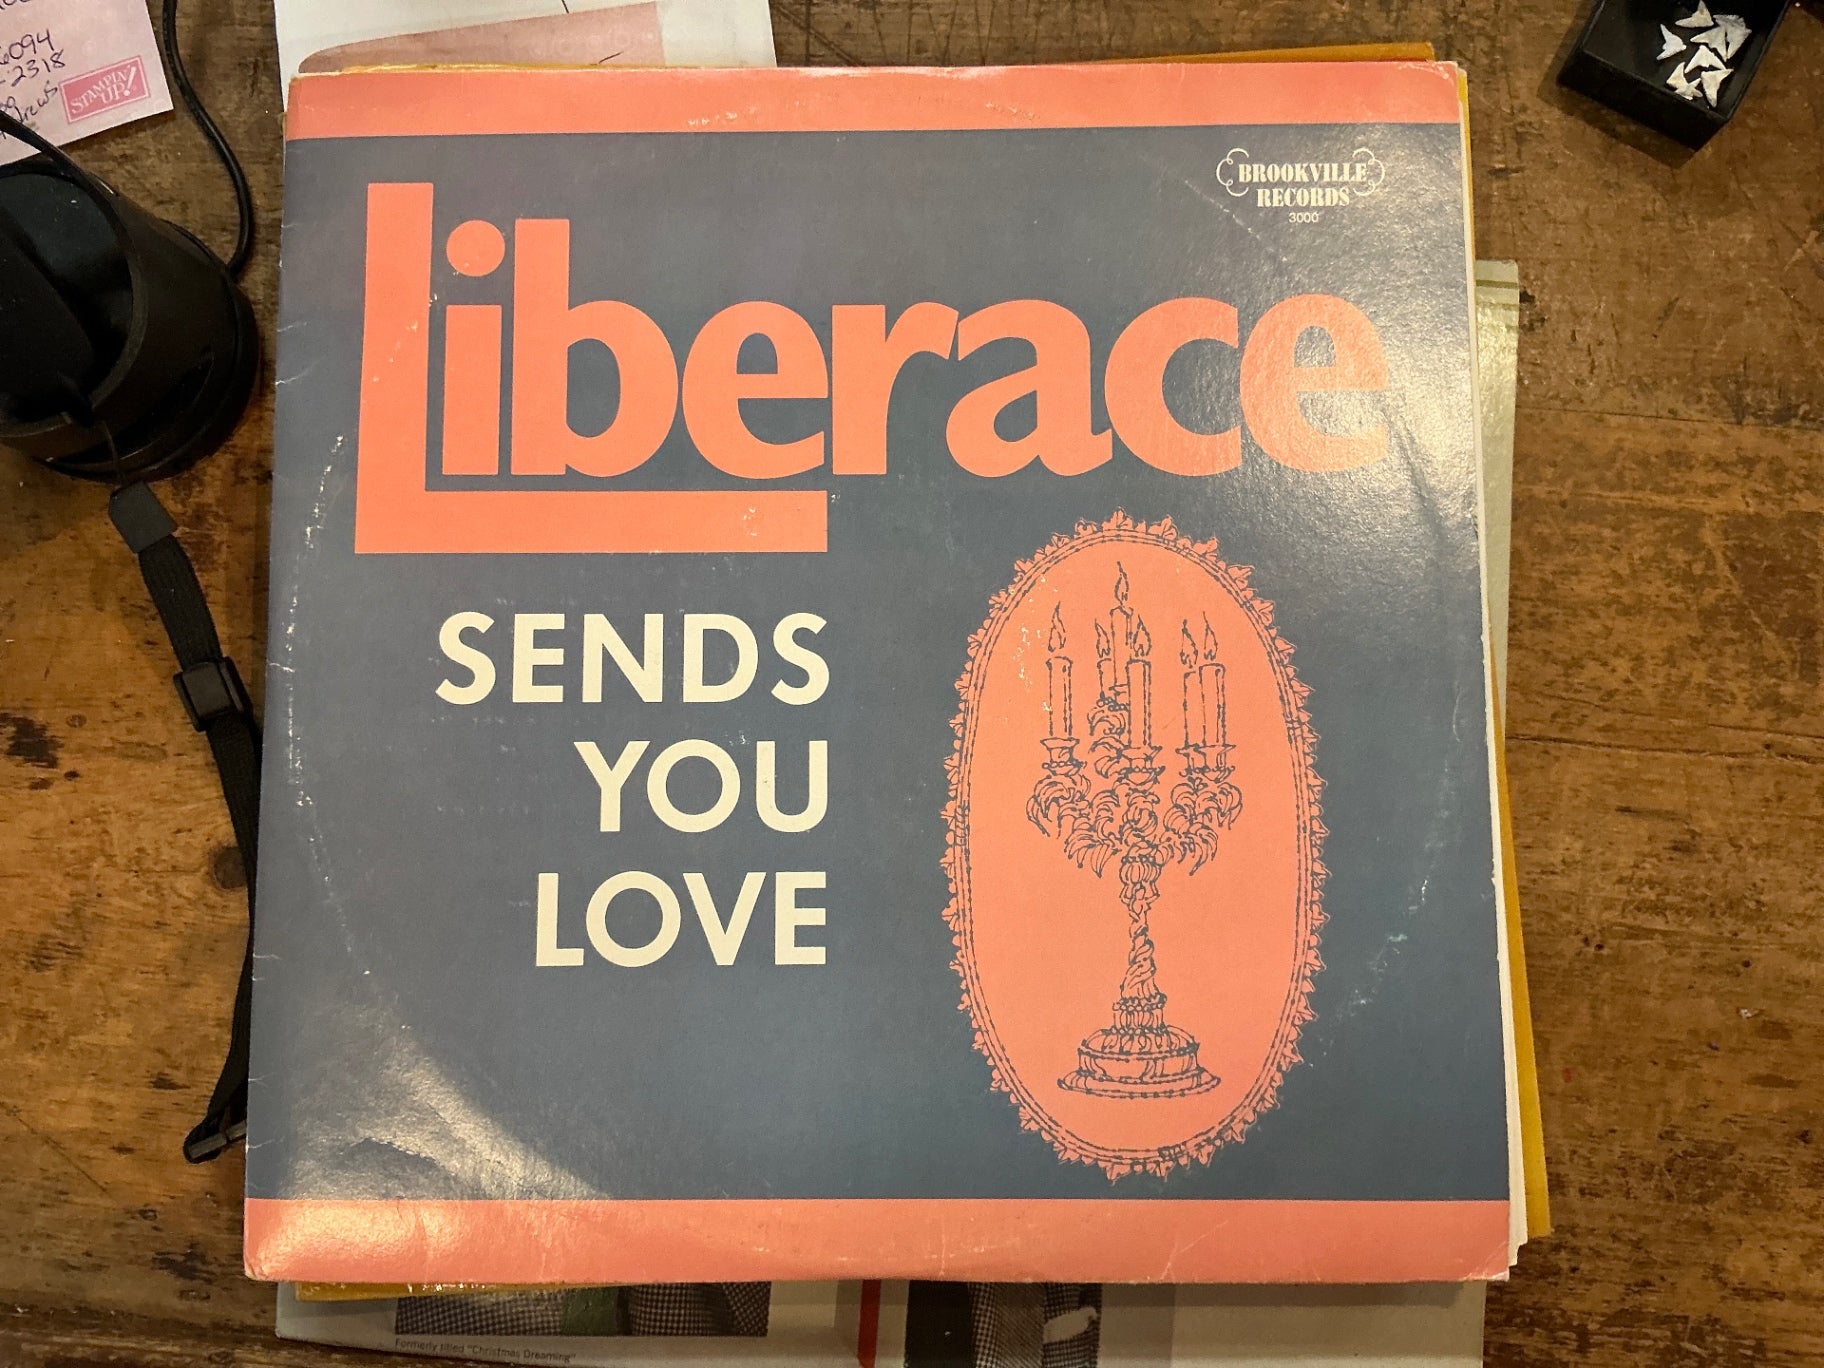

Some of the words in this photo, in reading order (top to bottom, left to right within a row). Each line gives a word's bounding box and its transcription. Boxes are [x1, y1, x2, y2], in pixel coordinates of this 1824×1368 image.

[101, 66, 136, 104] UP!
[1238, 162, 1368, 183] BROOKVILLE
[1256, 187, 1350, 208] RECORDS
[1288, 211, 1319, 224] 3000
[353, 181, 1392, 555] Liberace
[435, 611, 830, 706] SENDS
[573, 738, 829, 834] YOU
[535, 870, 828, 969] LOVE
[395, 1338, 438, 1352] Formerly
[440, 1342, 465, 1354] titled
